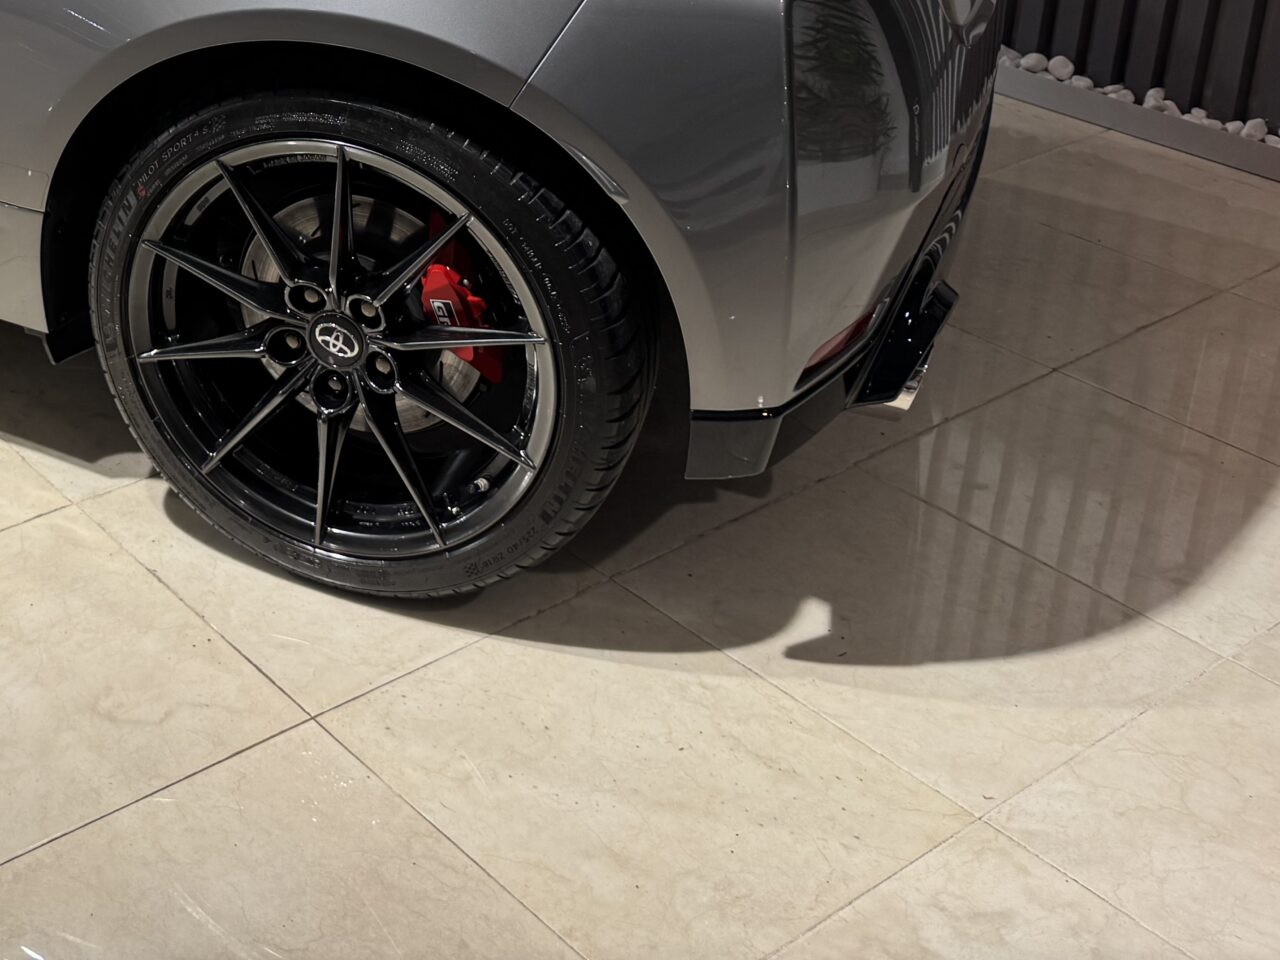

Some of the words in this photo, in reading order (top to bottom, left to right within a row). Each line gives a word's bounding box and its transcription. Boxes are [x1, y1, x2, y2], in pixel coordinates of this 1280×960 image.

[137, 160, 160, 187] PILOT
[161, 134, 193, 161] SPORT
[507, 527, 537, 554] 225/40
